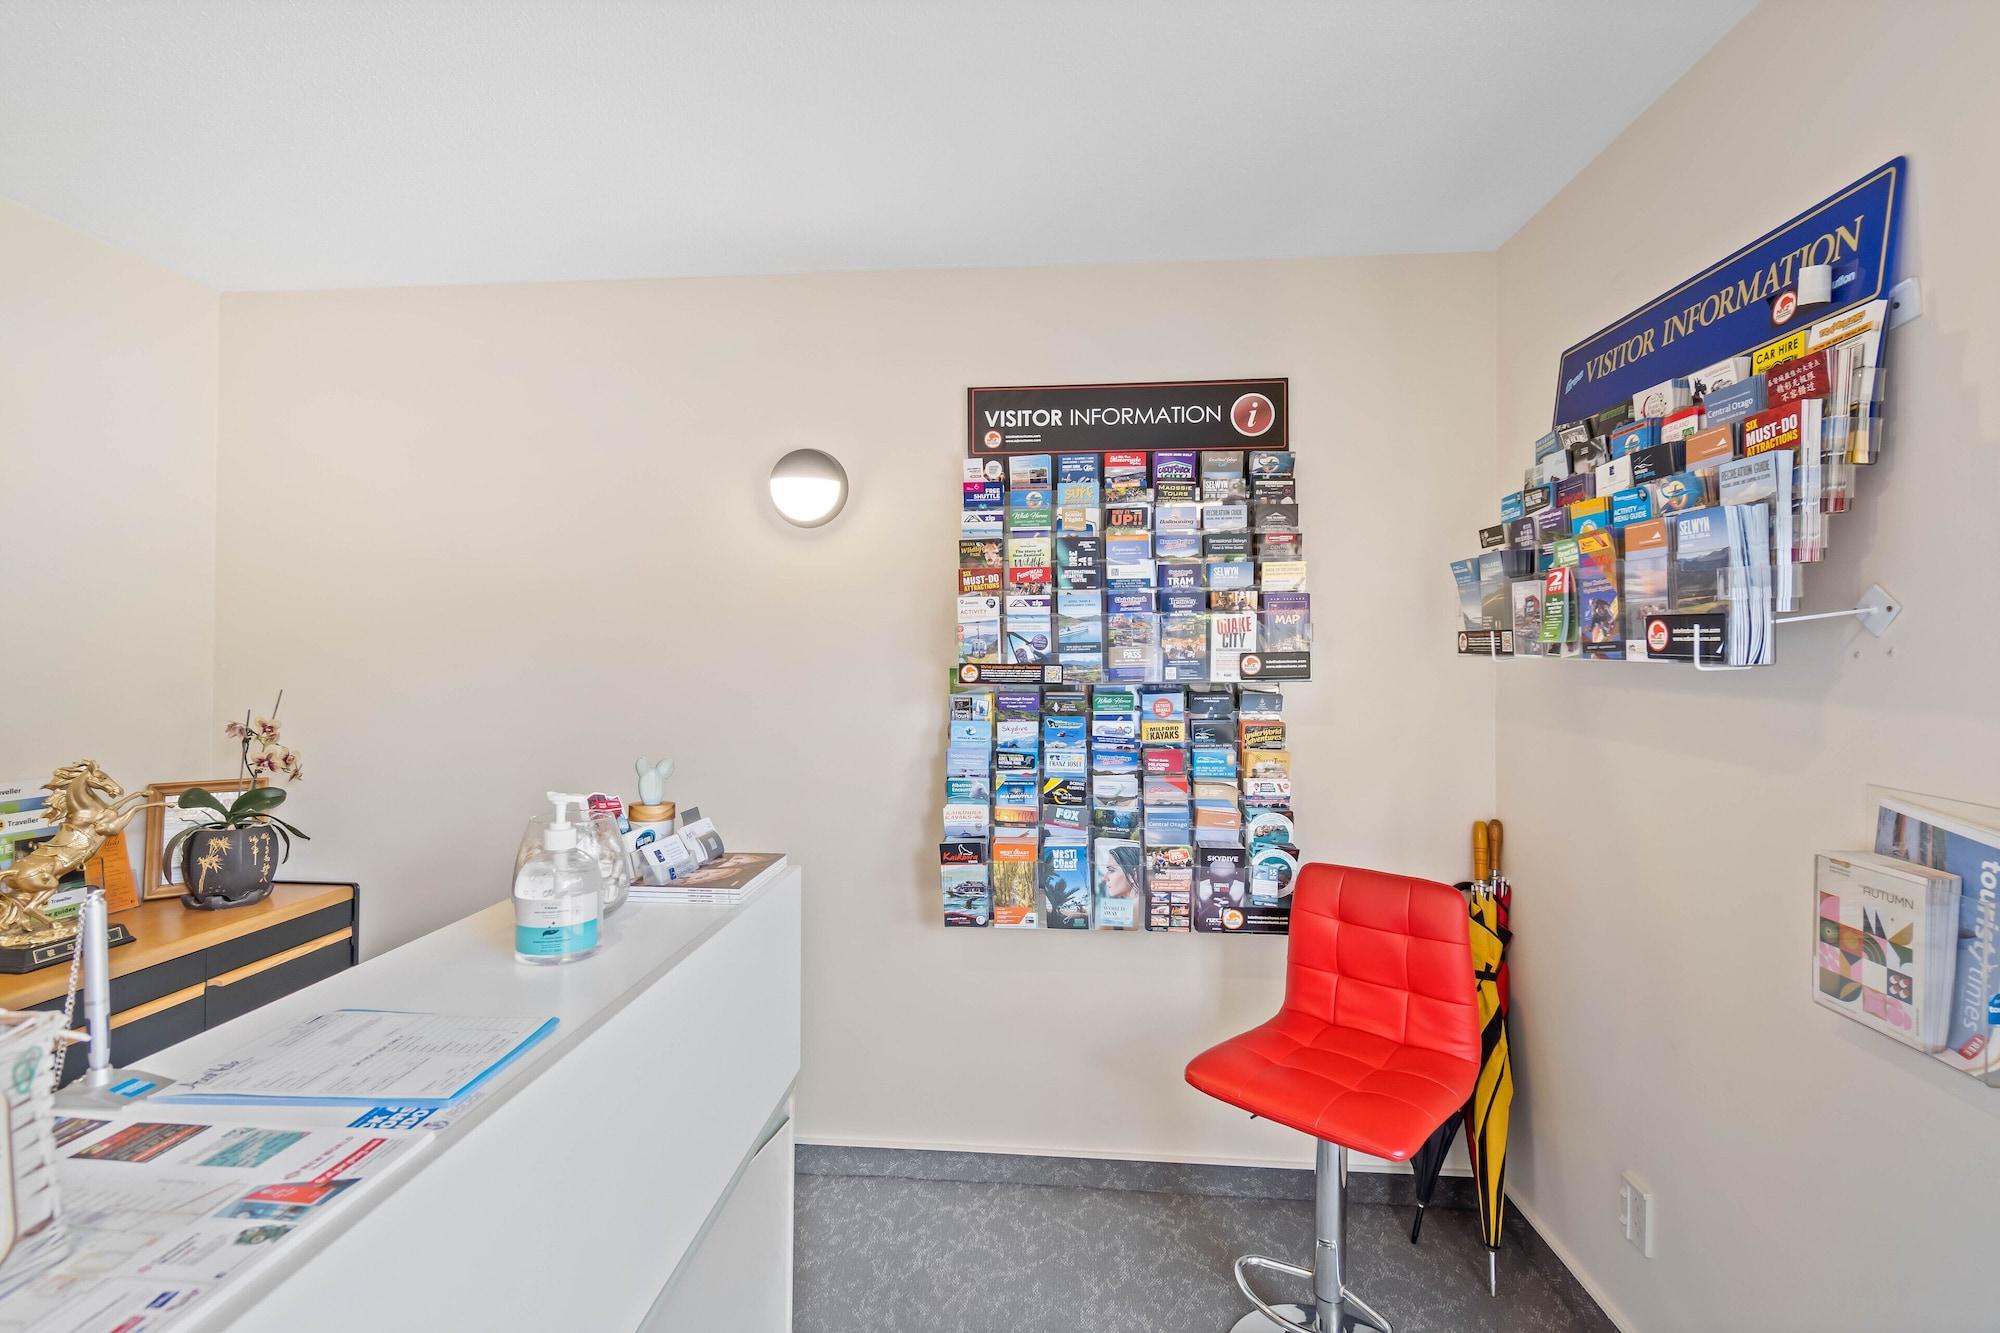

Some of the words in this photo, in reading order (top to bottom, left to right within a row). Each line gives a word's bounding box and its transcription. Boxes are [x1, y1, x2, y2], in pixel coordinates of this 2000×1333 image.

[1586, 328, 1655, 385] VISITOR
[1661, 215, 1865, 348] INFORMATION
[1756, 348, 1776, 365] CAR
[1778, 338, 1799, 355] HIRE
[1707, 404, 1730, 420] Central
[1731, 397, 1754, 411] Otago
[984, 408, 1063, 428] VISITOR
[1070, 404, 1221, 427] INFORMATION
[1745, 418, 1758, 433] SIX
[1746, 414, 1798, 447] MUST-DO
[1746, 429, 1799, 458] ATTRACTIONS
[1751, 461, 1770, 475] GUIDE
[985, 514, 996, 522] zip
[1111, 514, 1142, 526] UP!!
[1629, 510, 1648, 520] GUIDE
[1679, 516, 1711, 537] SELWYN
[1014, 558, 1044, 567] Wildlife
[1213, 567, 1239, 576] SELWYN
[963, 573, 1000, 586] MUST-DO
[1167, 577, 1194, 585] TRAM
[963, 583, 1000, 592] ATTRACTIONS
[1168, 597, 1198, 606] Tramway
[1216, 616, 1252, 635] QUAKE
[1274, 614, 1301, 625] MAP
[1222, 633, 1245, 648] CITY
[1123, 650, 1142, 659] PASS
[1149, 731, 1180, 741] KAYAKS
[1055, 807, 1080, 822] FOX
[7, 816, 39, 828] Traveller
[1169, 821, 1188, 829] Otago
[1053, 857, 1077, 871] COAST
[1207, 855, 1239, 863] SKYDIVE
[51, 895, 73, 905] Traveller
[1862, 886, 1915, 911] AUTUMN
[53, 906, 77, 918] guides
[1963, 962, 1989, 1032] times
[1962, 1037, 1986, 1057] FREE
